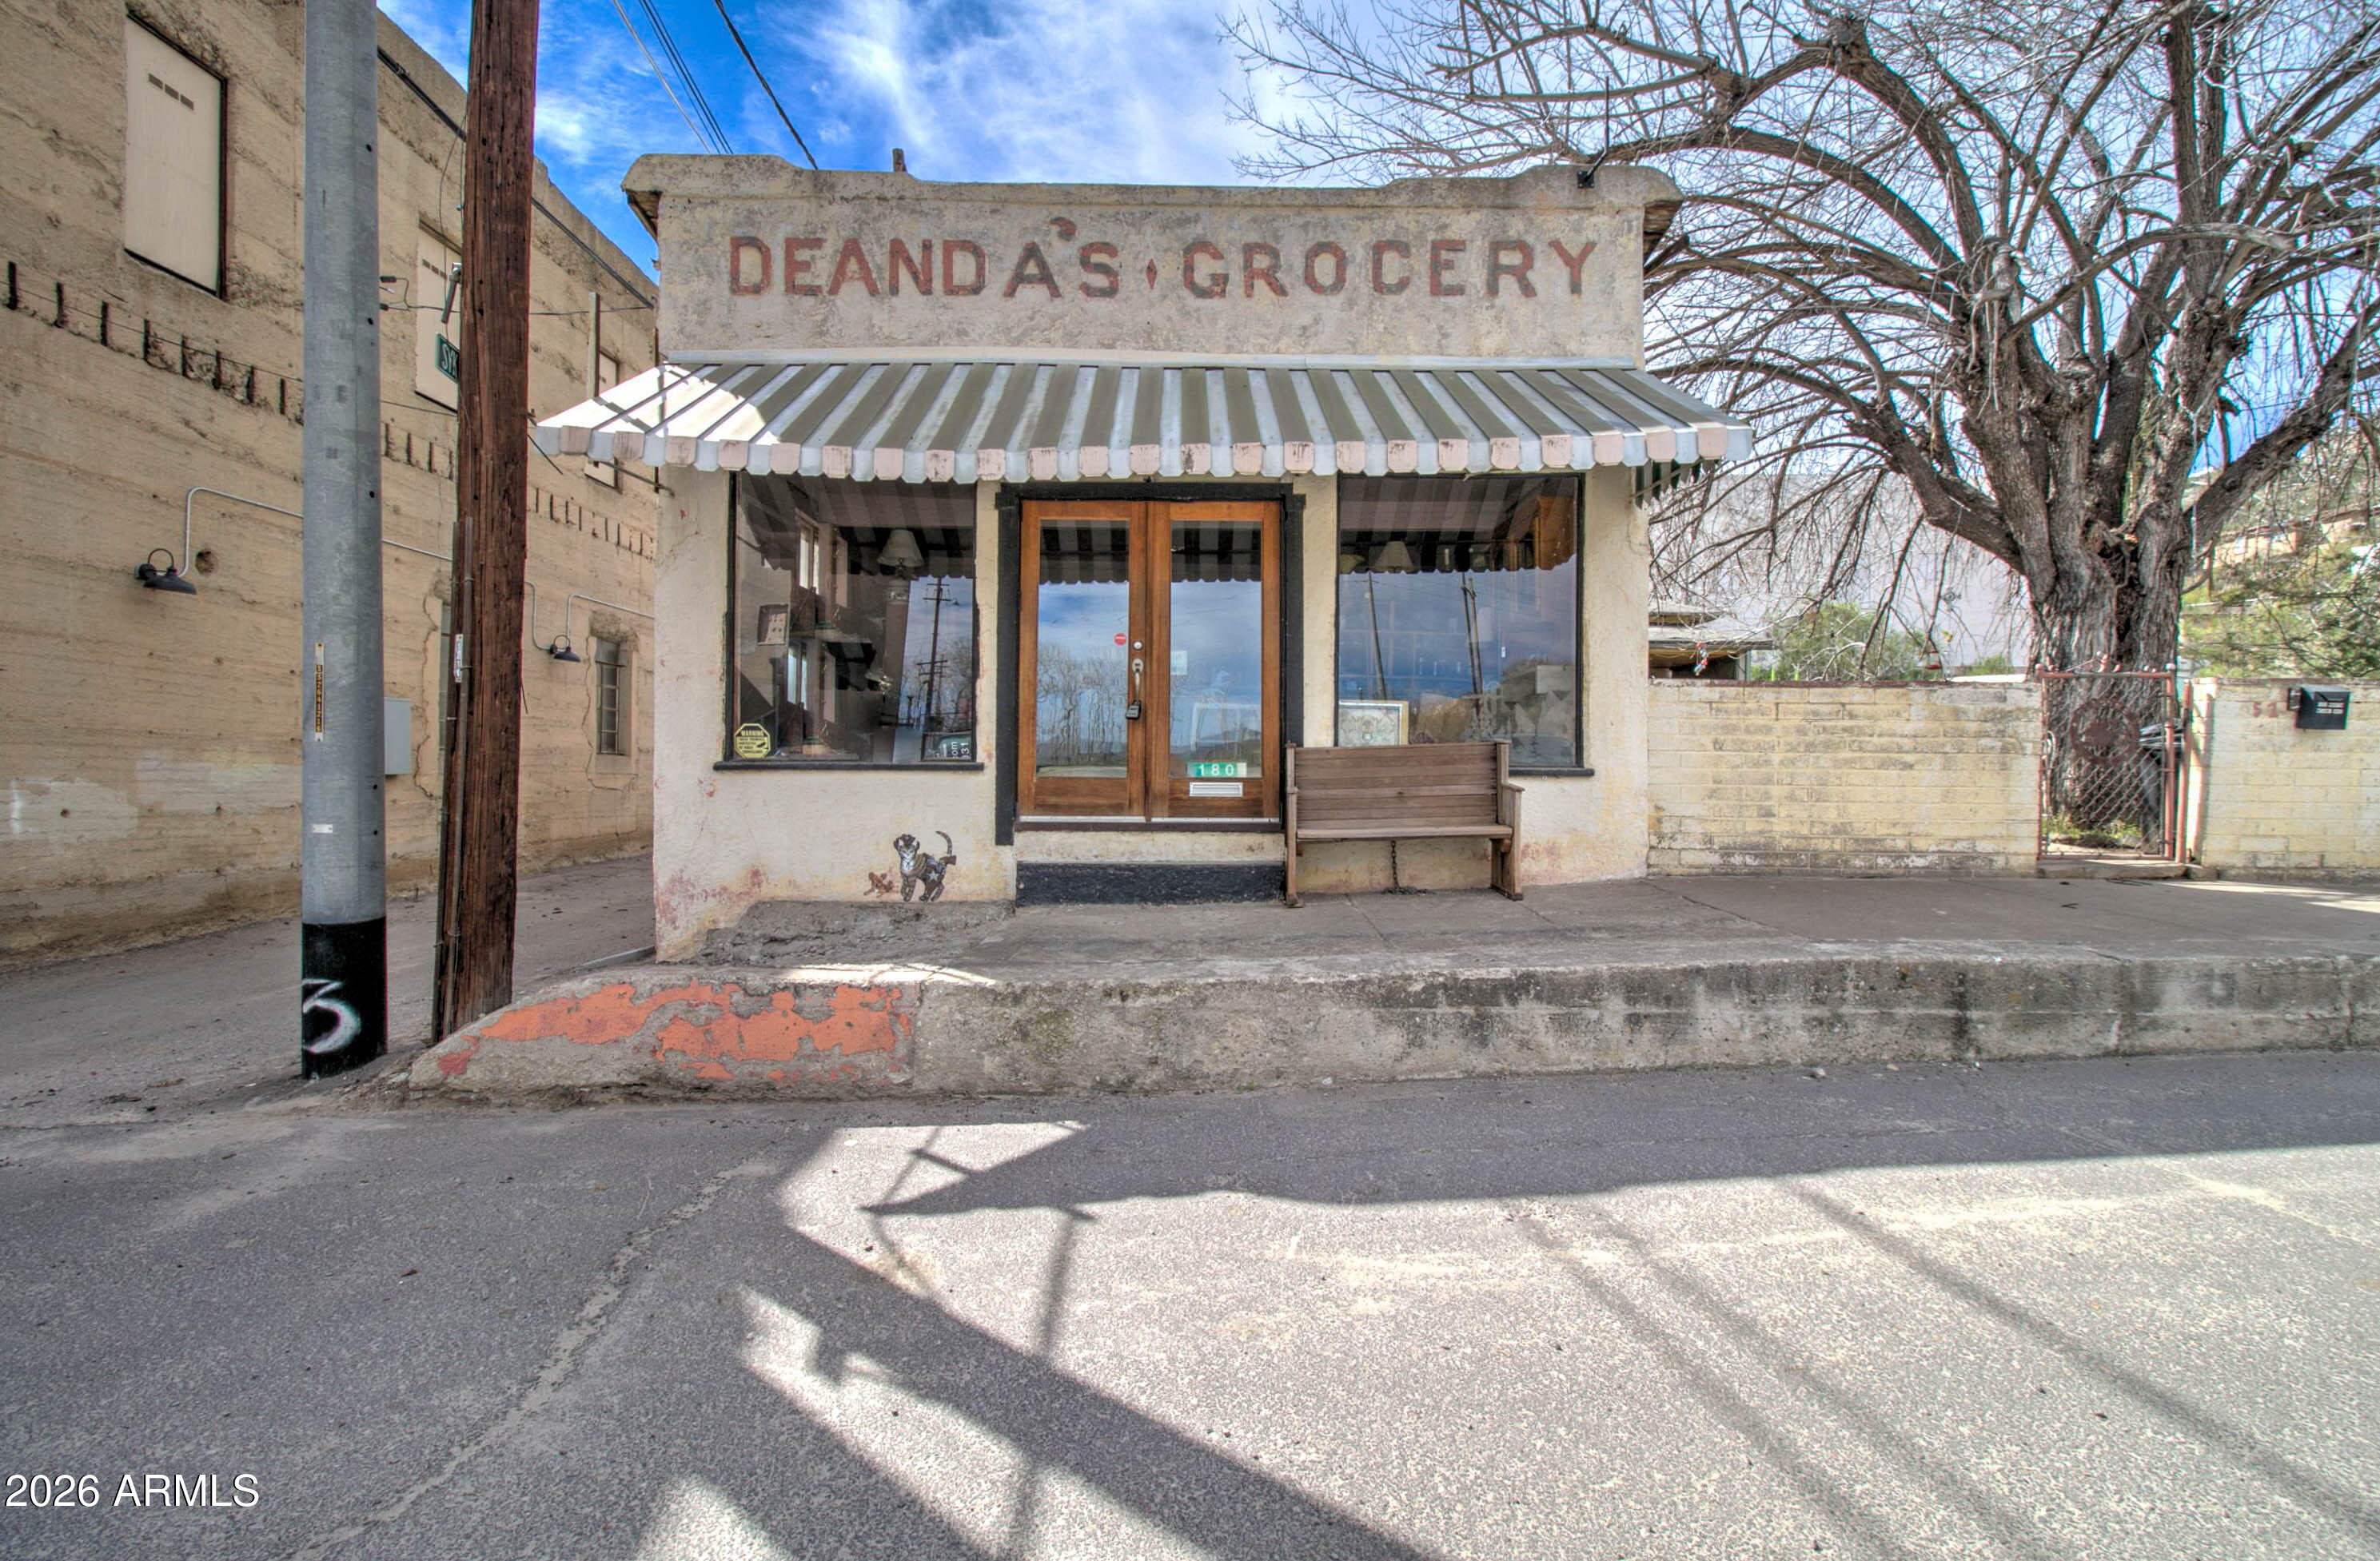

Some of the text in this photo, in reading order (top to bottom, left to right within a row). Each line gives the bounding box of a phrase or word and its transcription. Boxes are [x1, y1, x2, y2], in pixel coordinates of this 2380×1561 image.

[729, 216, 1597, 299] DEANDA'S GROCERY
[1199, 764, 1234, 776] 180
